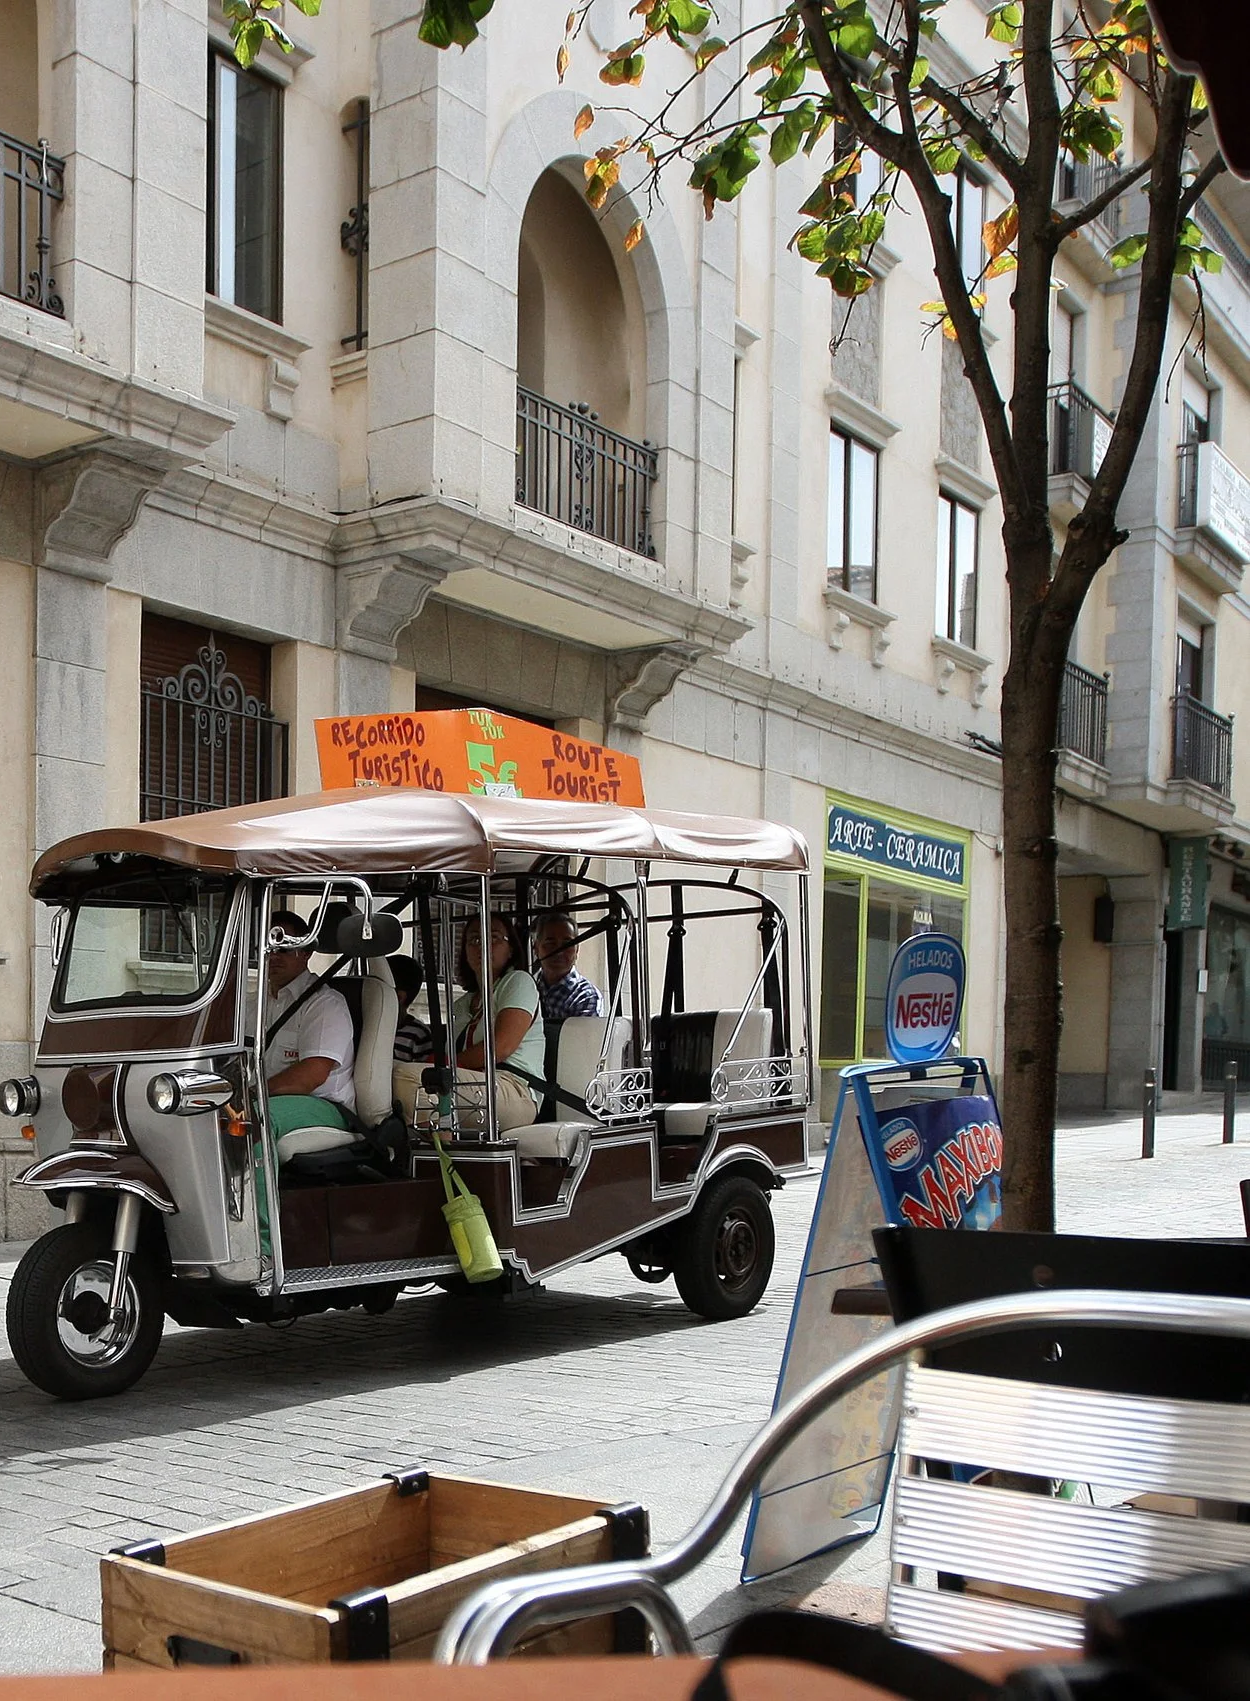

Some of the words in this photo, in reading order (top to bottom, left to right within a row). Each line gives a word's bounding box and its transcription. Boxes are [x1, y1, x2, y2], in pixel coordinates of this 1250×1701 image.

[467, 710, 494, 727] TUK
[481, 725, 505, 741] TUK
[551, 734, 618, 778] ROUTE
[829, 816, 877, 851] ARTE
[885, 833, 961, 876] CERAMICA
[908, 949, 954, 970] HELADOS
[895, 991, 955, 1029] Nestlé
